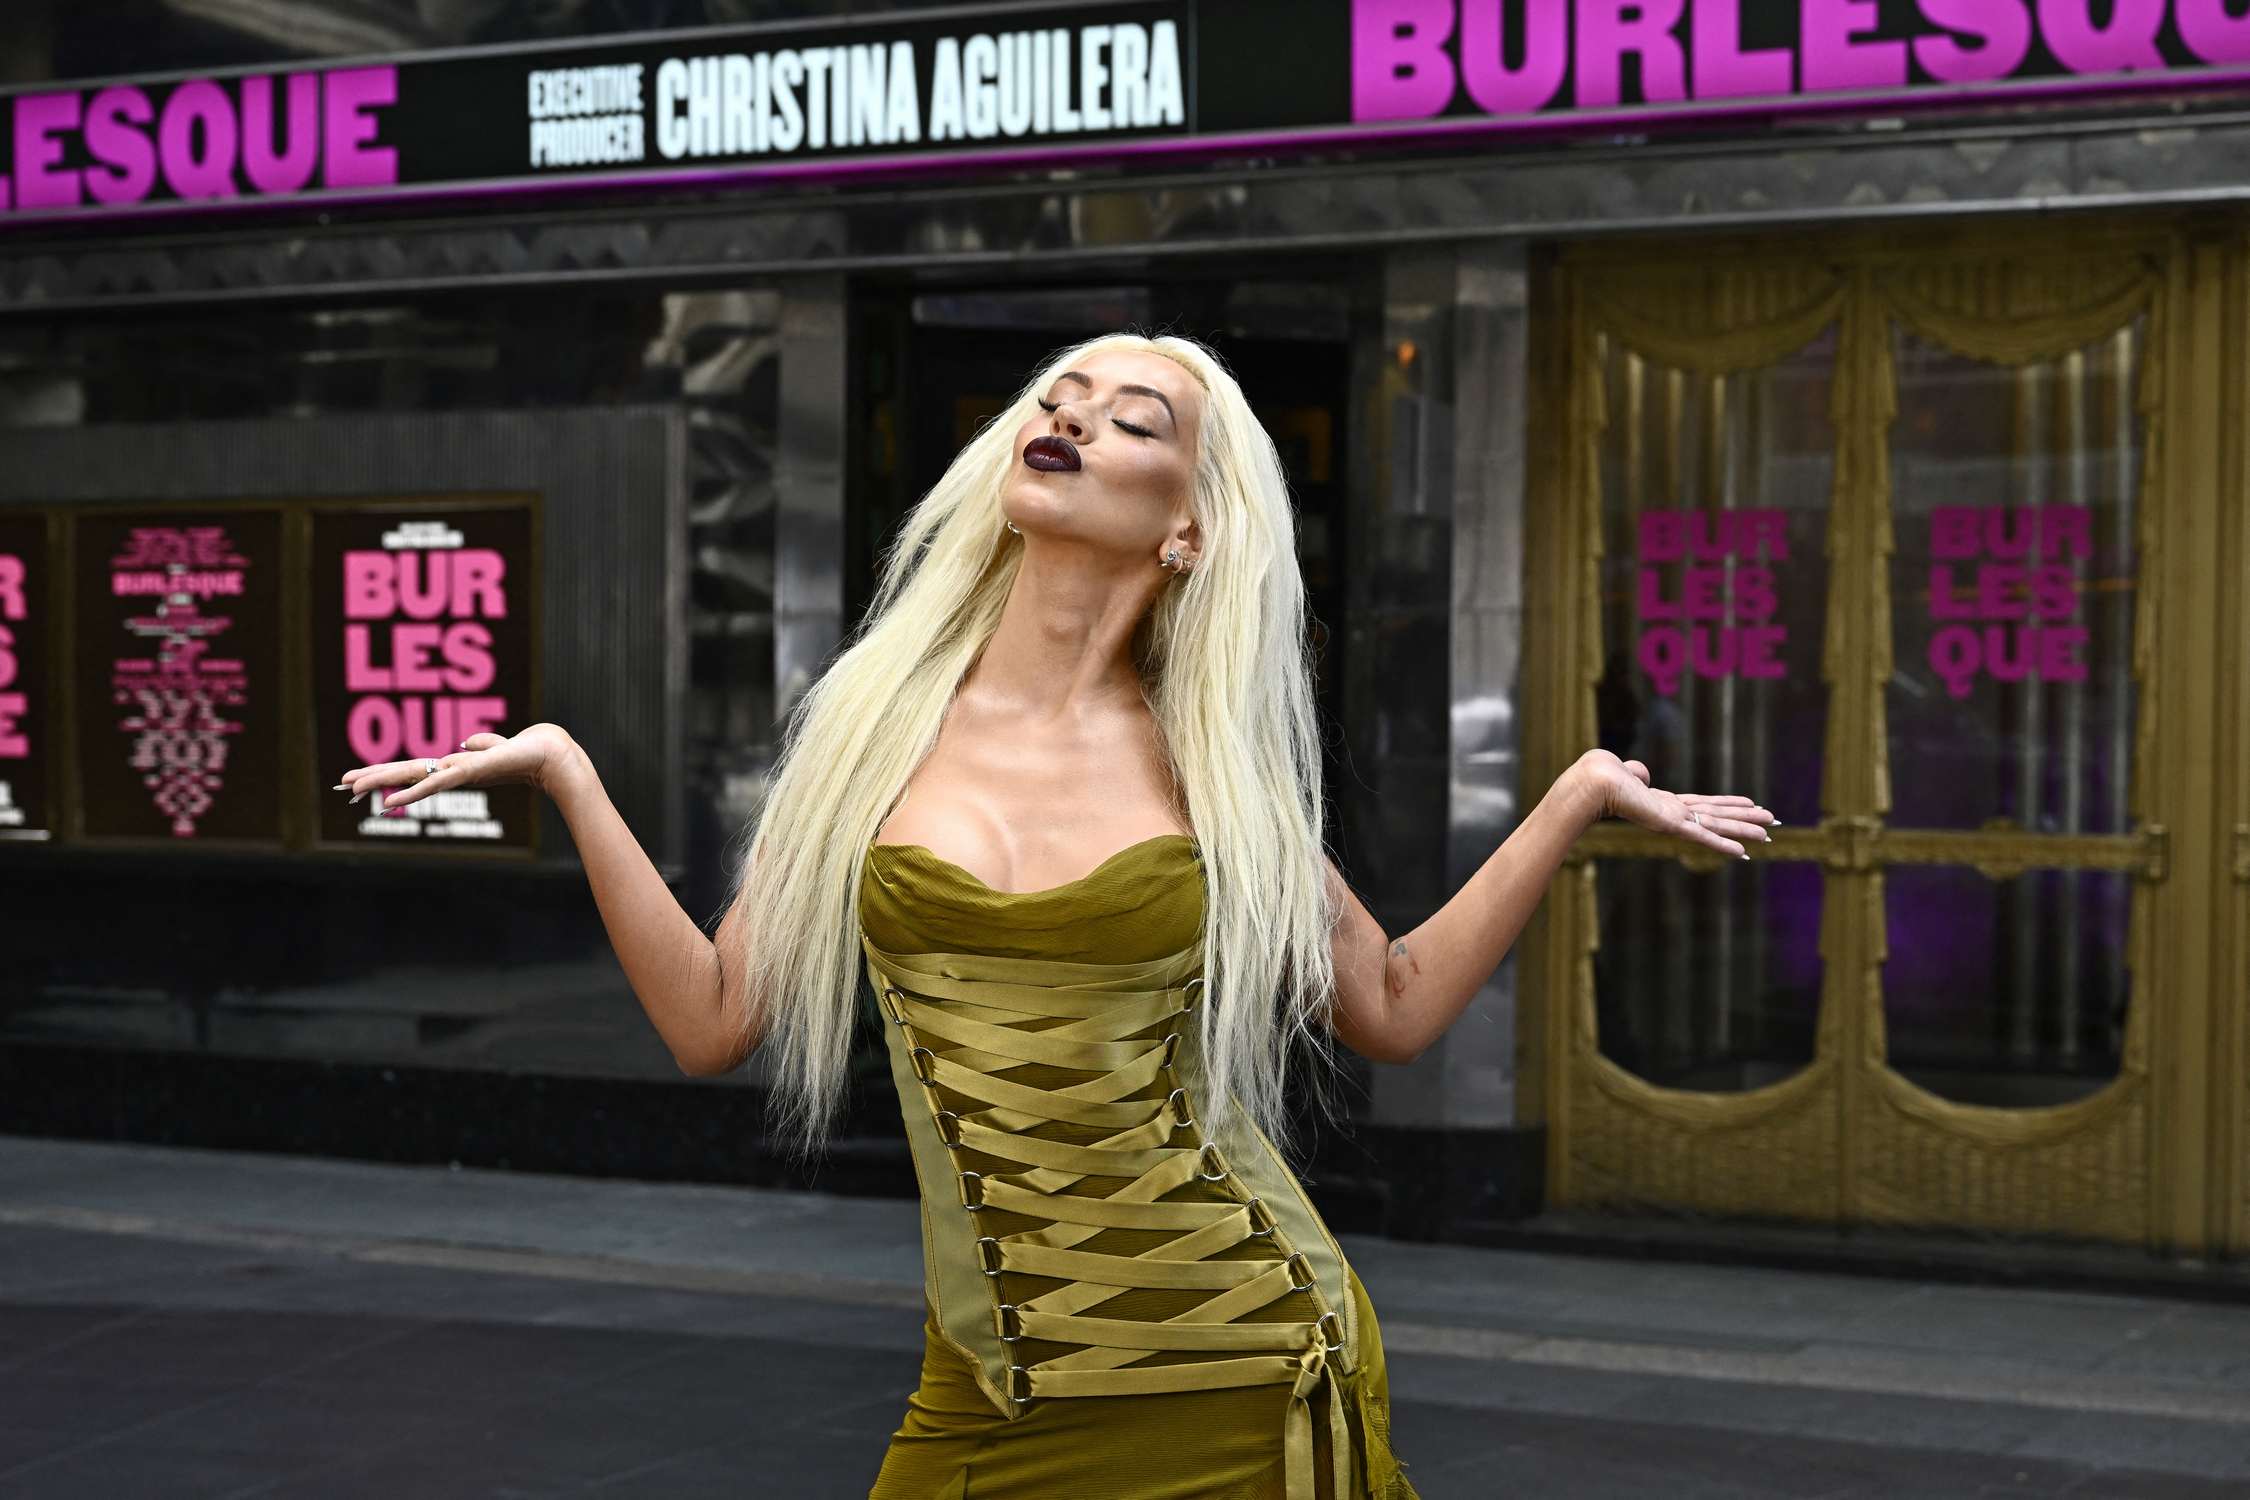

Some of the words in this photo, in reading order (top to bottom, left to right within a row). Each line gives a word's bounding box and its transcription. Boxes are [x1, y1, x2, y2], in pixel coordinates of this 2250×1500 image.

[528, 63, 645, 118] EXECUTIVE
[656, 41, 921, 158] CHRISTINA
[929, 20, 1184, 138] AGUILERA
[0, 65, 398, 212] ESQUE
[529, 114, 645, 168] PRODUCER
[1638, 509, 1788, 560] BUR
[1930, 506, 2092, 559] BUR
[343, 549, 506, 619] BUR
[1638, 566, 1777, 619] LES
[1930, 565, 2078, 619] LES
[344, 622, 496, 692] LES
[1638, 626, 1787, 695] QUE
[1929, 625, 2089, 697] QUE
